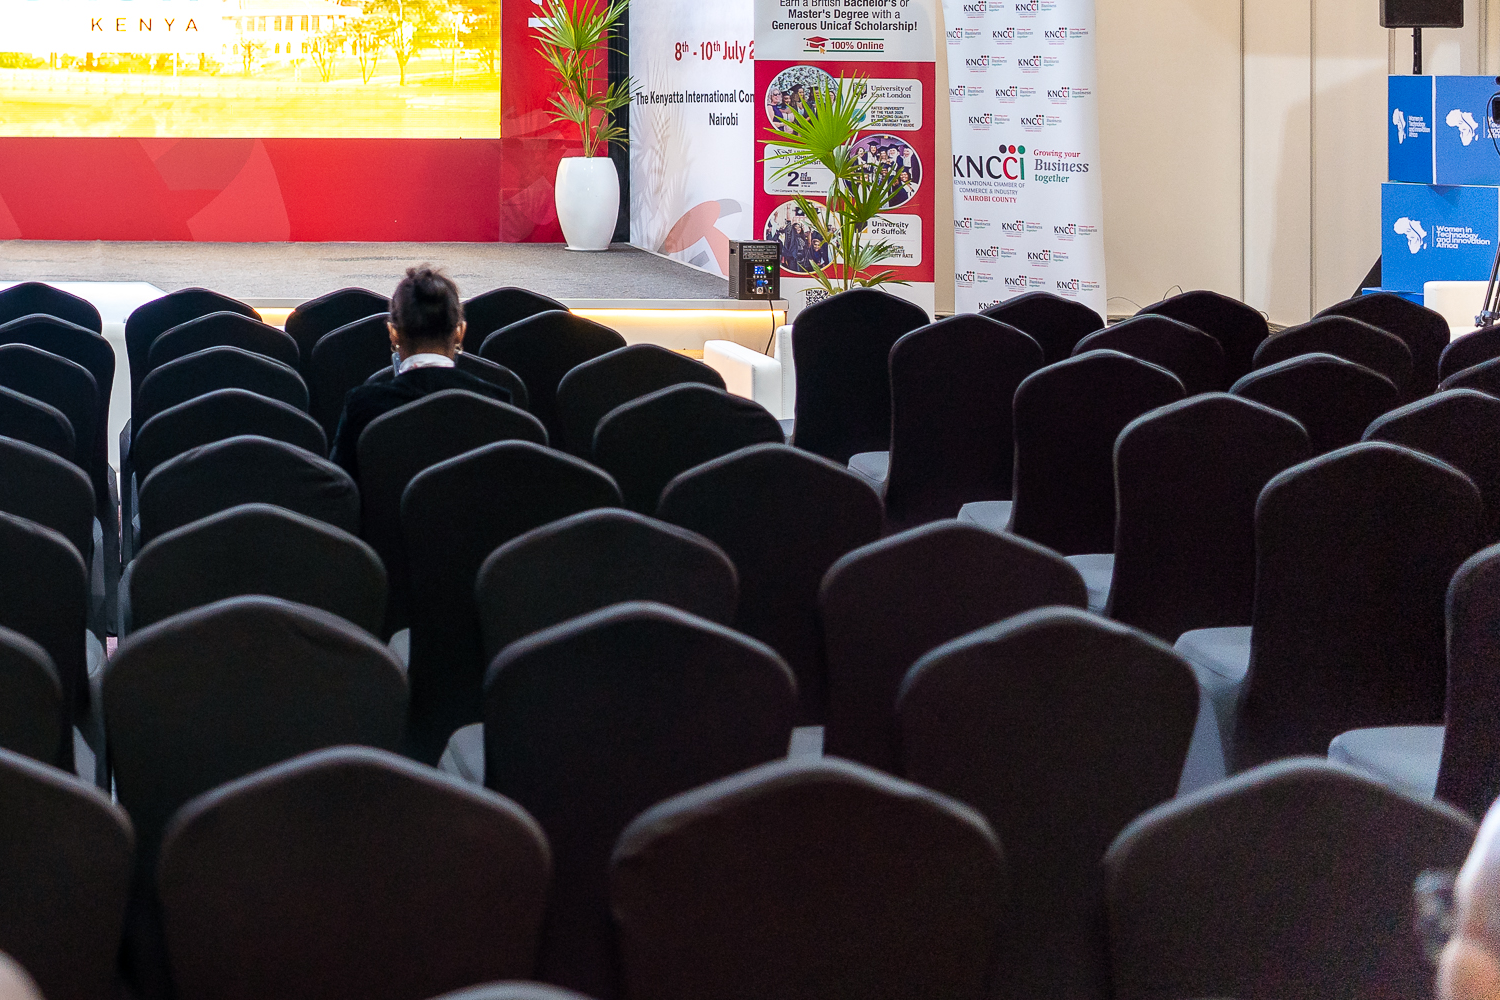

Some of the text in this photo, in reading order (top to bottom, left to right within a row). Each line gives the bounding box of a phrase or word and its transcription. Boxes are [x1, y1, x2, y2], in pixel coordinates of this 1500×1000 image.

[803, 0, 808, 7] a
[900, 0, 909, 7] or
[788, 9, 900, 20] Master's Degree with a
[91, 17, 199, 32] KENYA
[772, 21, 917, 32] Generous Unicaf Scholarship!
[831, 41, 854, 49] 100%
[700, 41, 721, 61] 10th
[723, 43, 746, 64] July
[871, 85, 904, 94] University
[636, 93, 648, 105] The
[650, 92, 684, 106] Kenyatta
[685, 90, 738, 104] International
[709, 112, 738, 127] Nairobi
[1034, 149, 1062, 158] Growing
[953, 144, 1026, 180] KNCCI
[1034, 159, 1089, 172] Business
[1034, 174, 1069, 184] together
[1436, 231, 1478, 239] Technology
